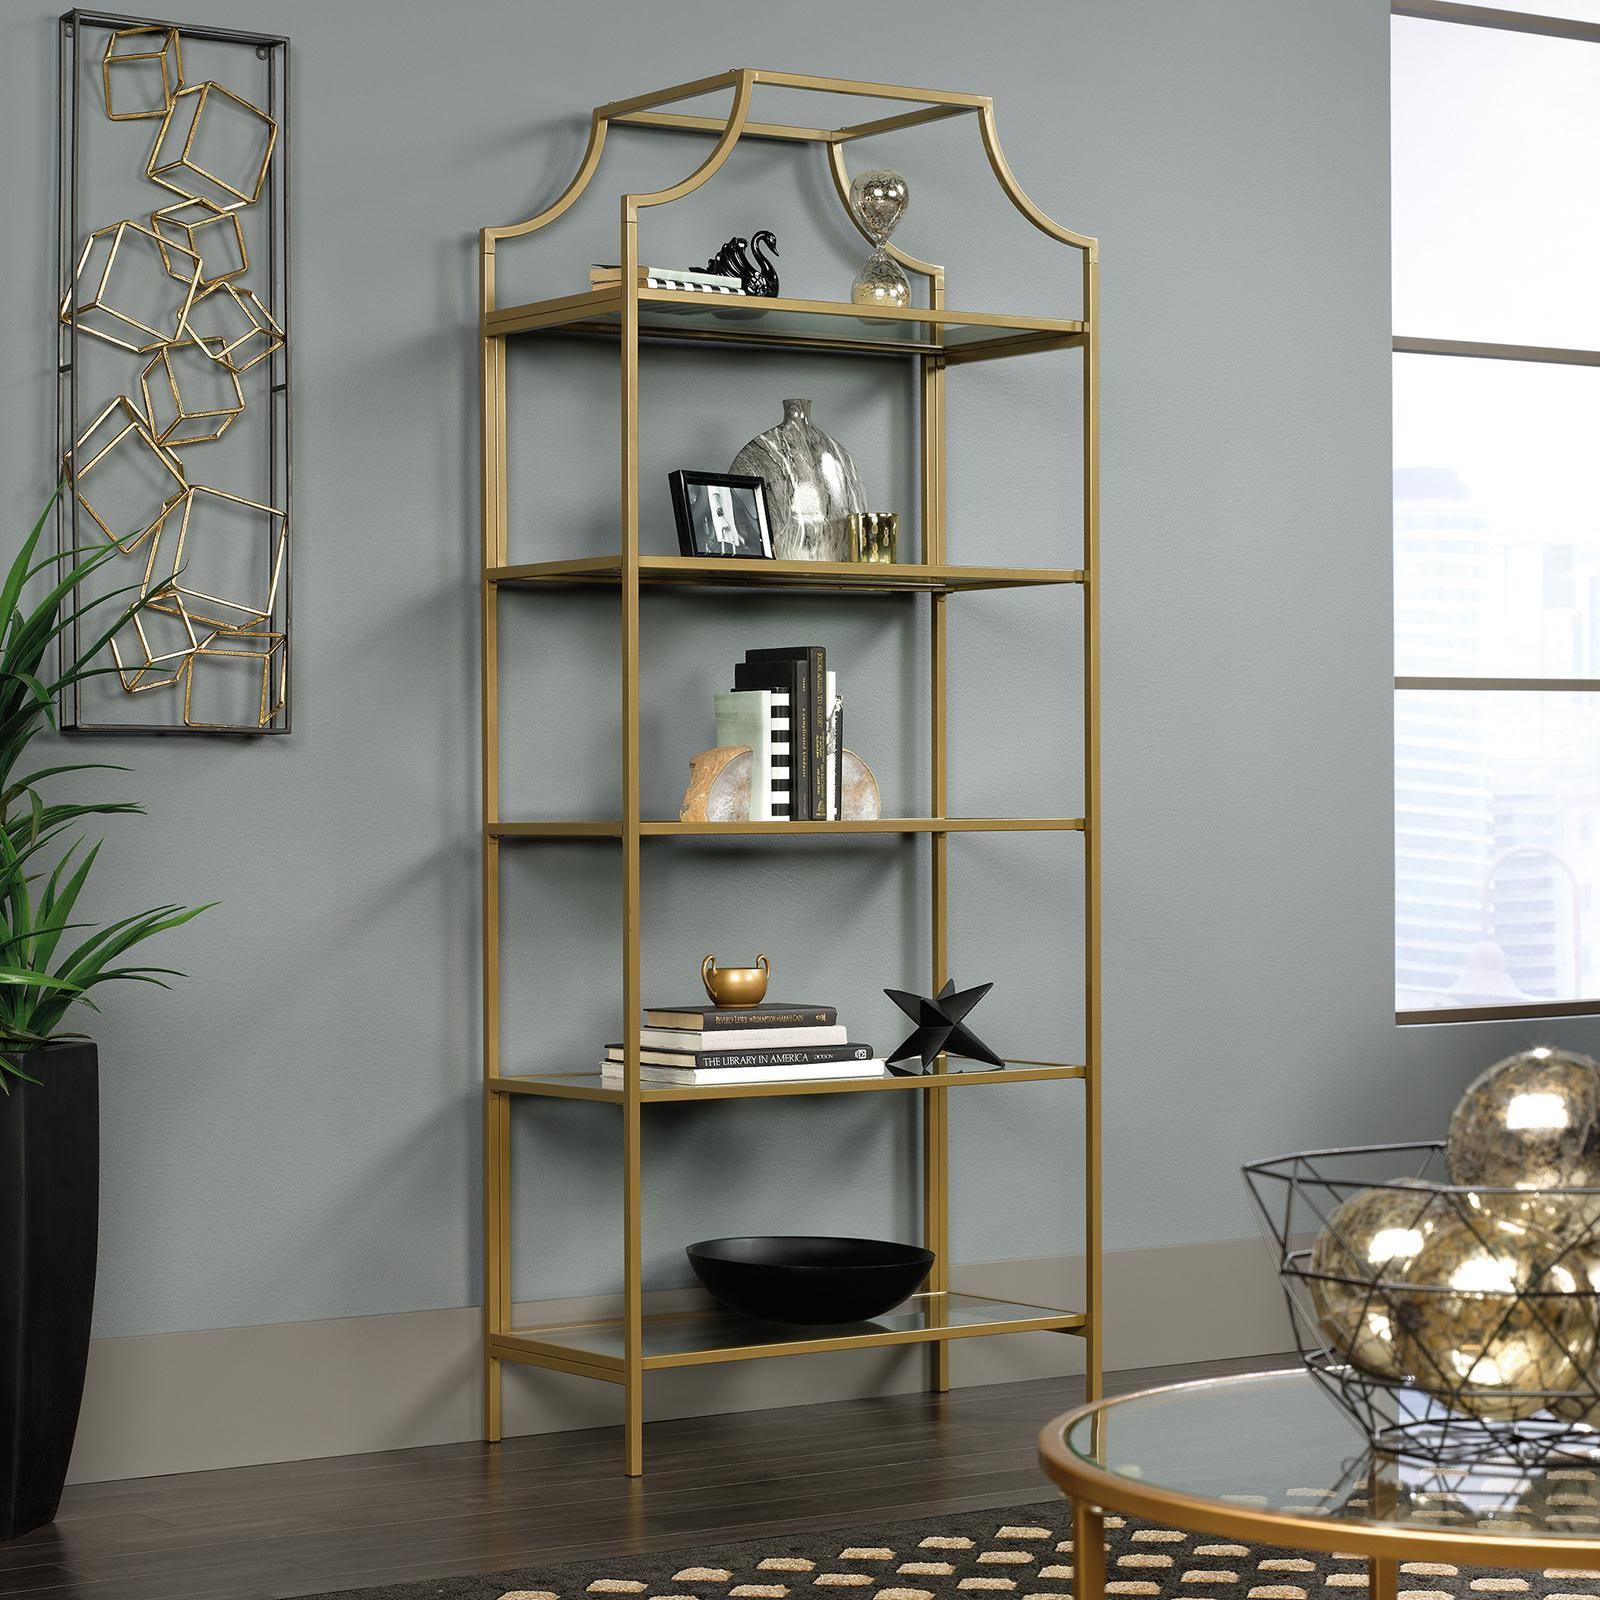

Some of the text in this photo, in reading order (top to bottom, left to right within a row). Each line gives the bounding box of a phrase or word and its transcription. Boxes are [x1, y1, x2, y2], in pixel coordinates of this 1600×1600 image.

[702, 1053, 809, 1067] THE LIBRARY IN AMERICA
